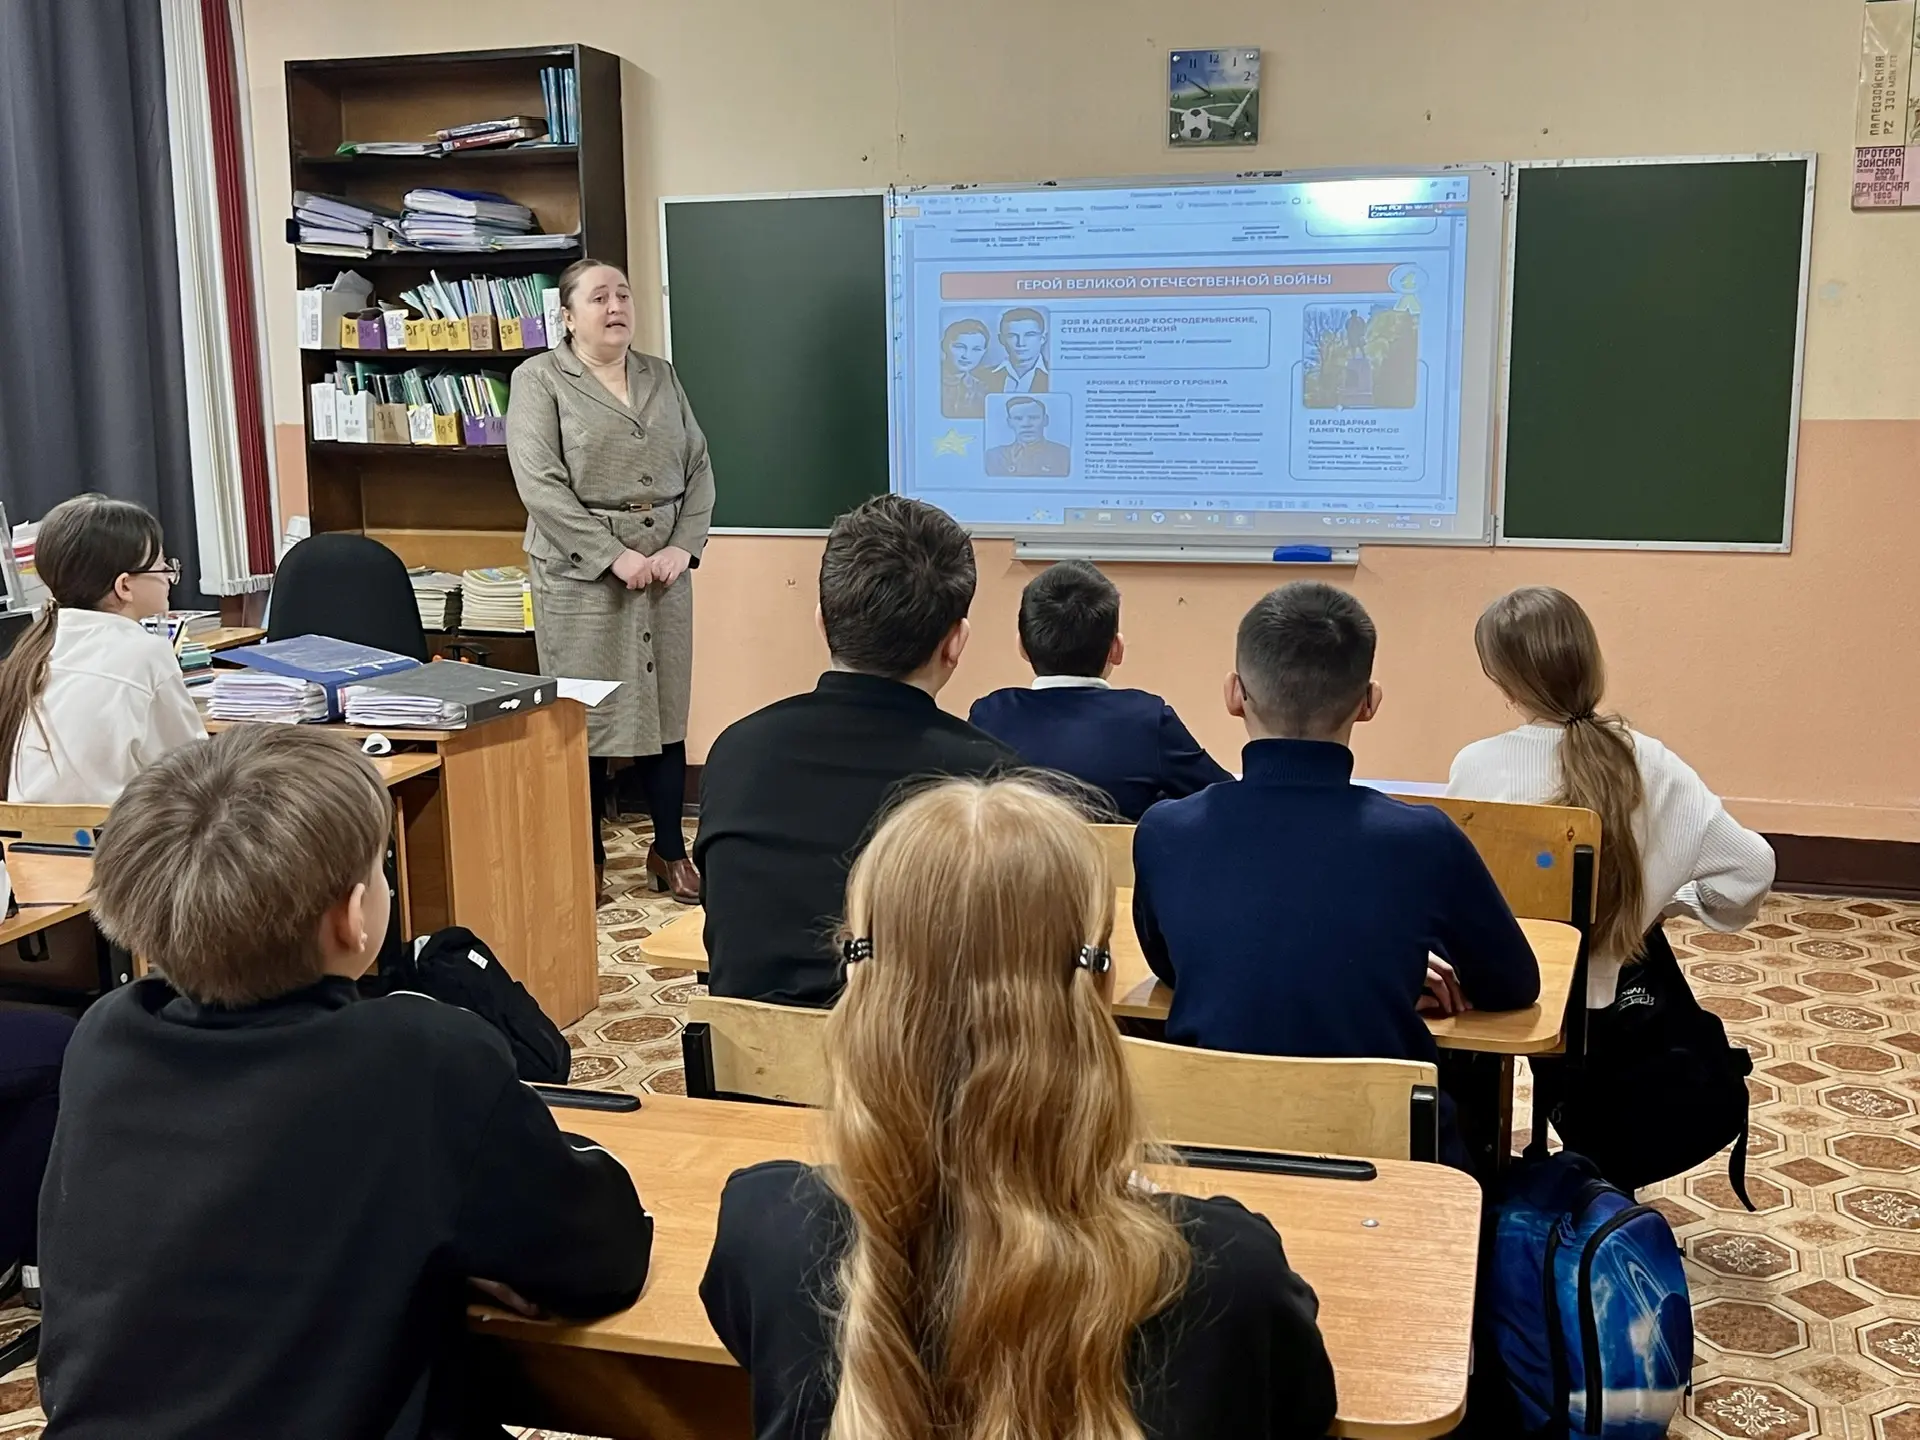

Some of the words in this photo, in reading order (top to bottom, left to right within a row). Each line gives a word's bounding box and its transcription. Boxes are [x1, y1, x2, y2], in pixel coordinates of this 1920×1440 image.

[1189, 58, 1197, 69] 11
[1209, 54, 1220, 64] 12
[1176, 73, 1187, 83] 10
[1244, 71, 1251, 81] 2
[1869, 55, 1885, 136] ПАЛЕОЗОЙСКАЯ
[1885, 90, 1896, 111] 330
[1883, 120, 1894, 135] PZ
[1857, 158, 1901, 168] ЗОЙСКАЯ
[1855, 181, 1910, 192] АРХЕЙСКАЯ
[1016, 277, 1063, 291] ГЕРОЙ
[1066, 275, 1137, 290] ВЕЛИКОЙ
[1140, 273, 1270, 289] ОТЕЧЕСТВЕННОЙ
[1273, 272, 1332, 287] ВОЙНЫ
[1061, 317, 1080, 325] ЗОЯ
[1082, 317, 1090, 325] И
[1092, 317, 1150, 326] АЛЕКСАНДР
[1153, 316, 1258, 325] КОСМОДЕМЬЯНСКИЕ,
[1061, 326, 1098, 334] СТЕПАН
[1101, 325, 1177, 333] ПЕРЕКАЛЬСКИЙ
